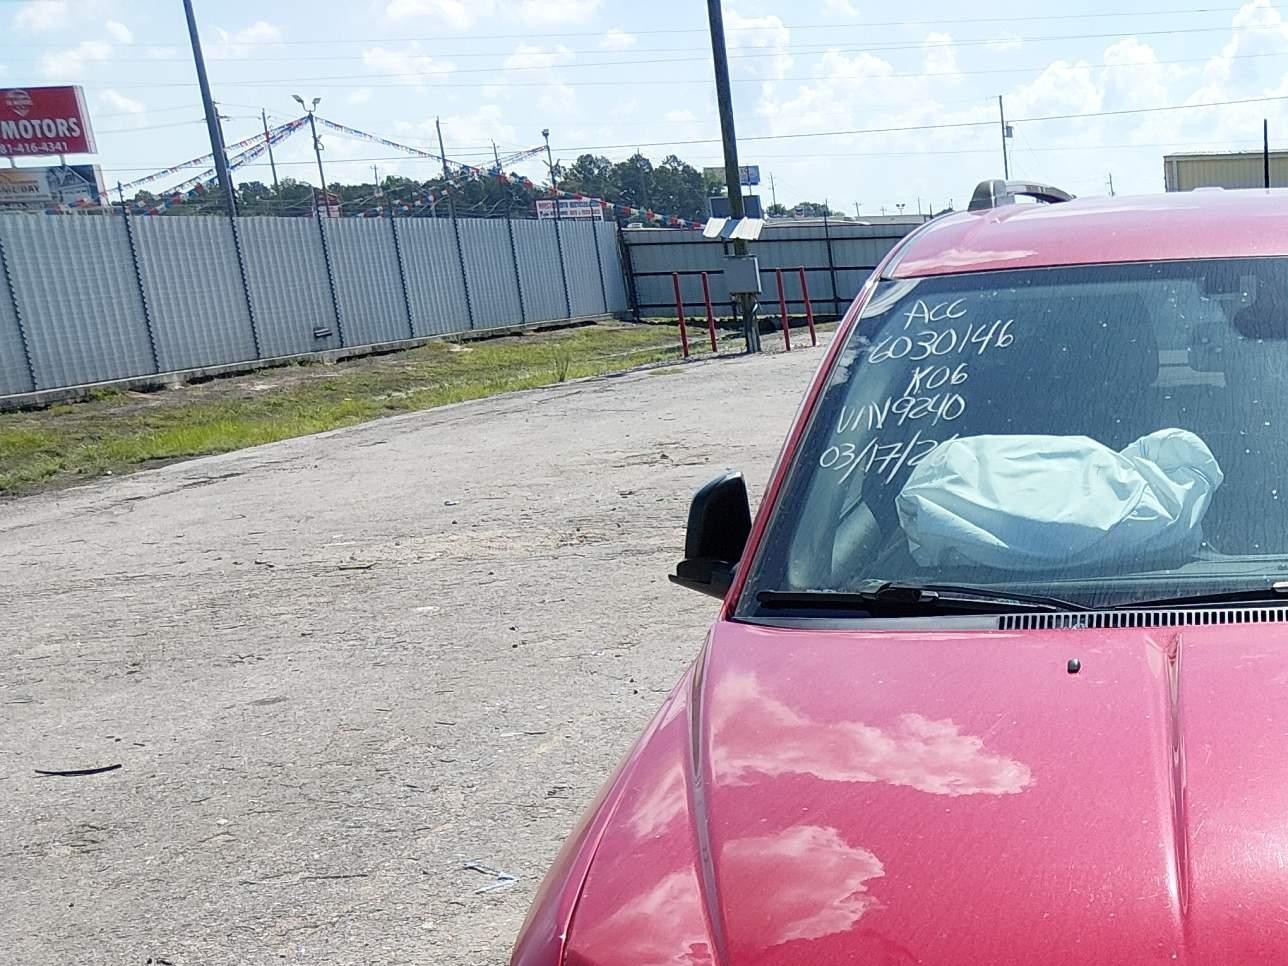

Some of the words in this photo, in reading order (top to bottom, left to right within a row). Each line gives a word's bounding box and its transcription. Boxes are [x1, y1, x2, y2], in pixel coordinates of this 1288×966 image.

[1, 117, 81, 139] MOTORS
[903, 297, 967, 330] ACC
[868, 319, 1014, 363] 6030146
